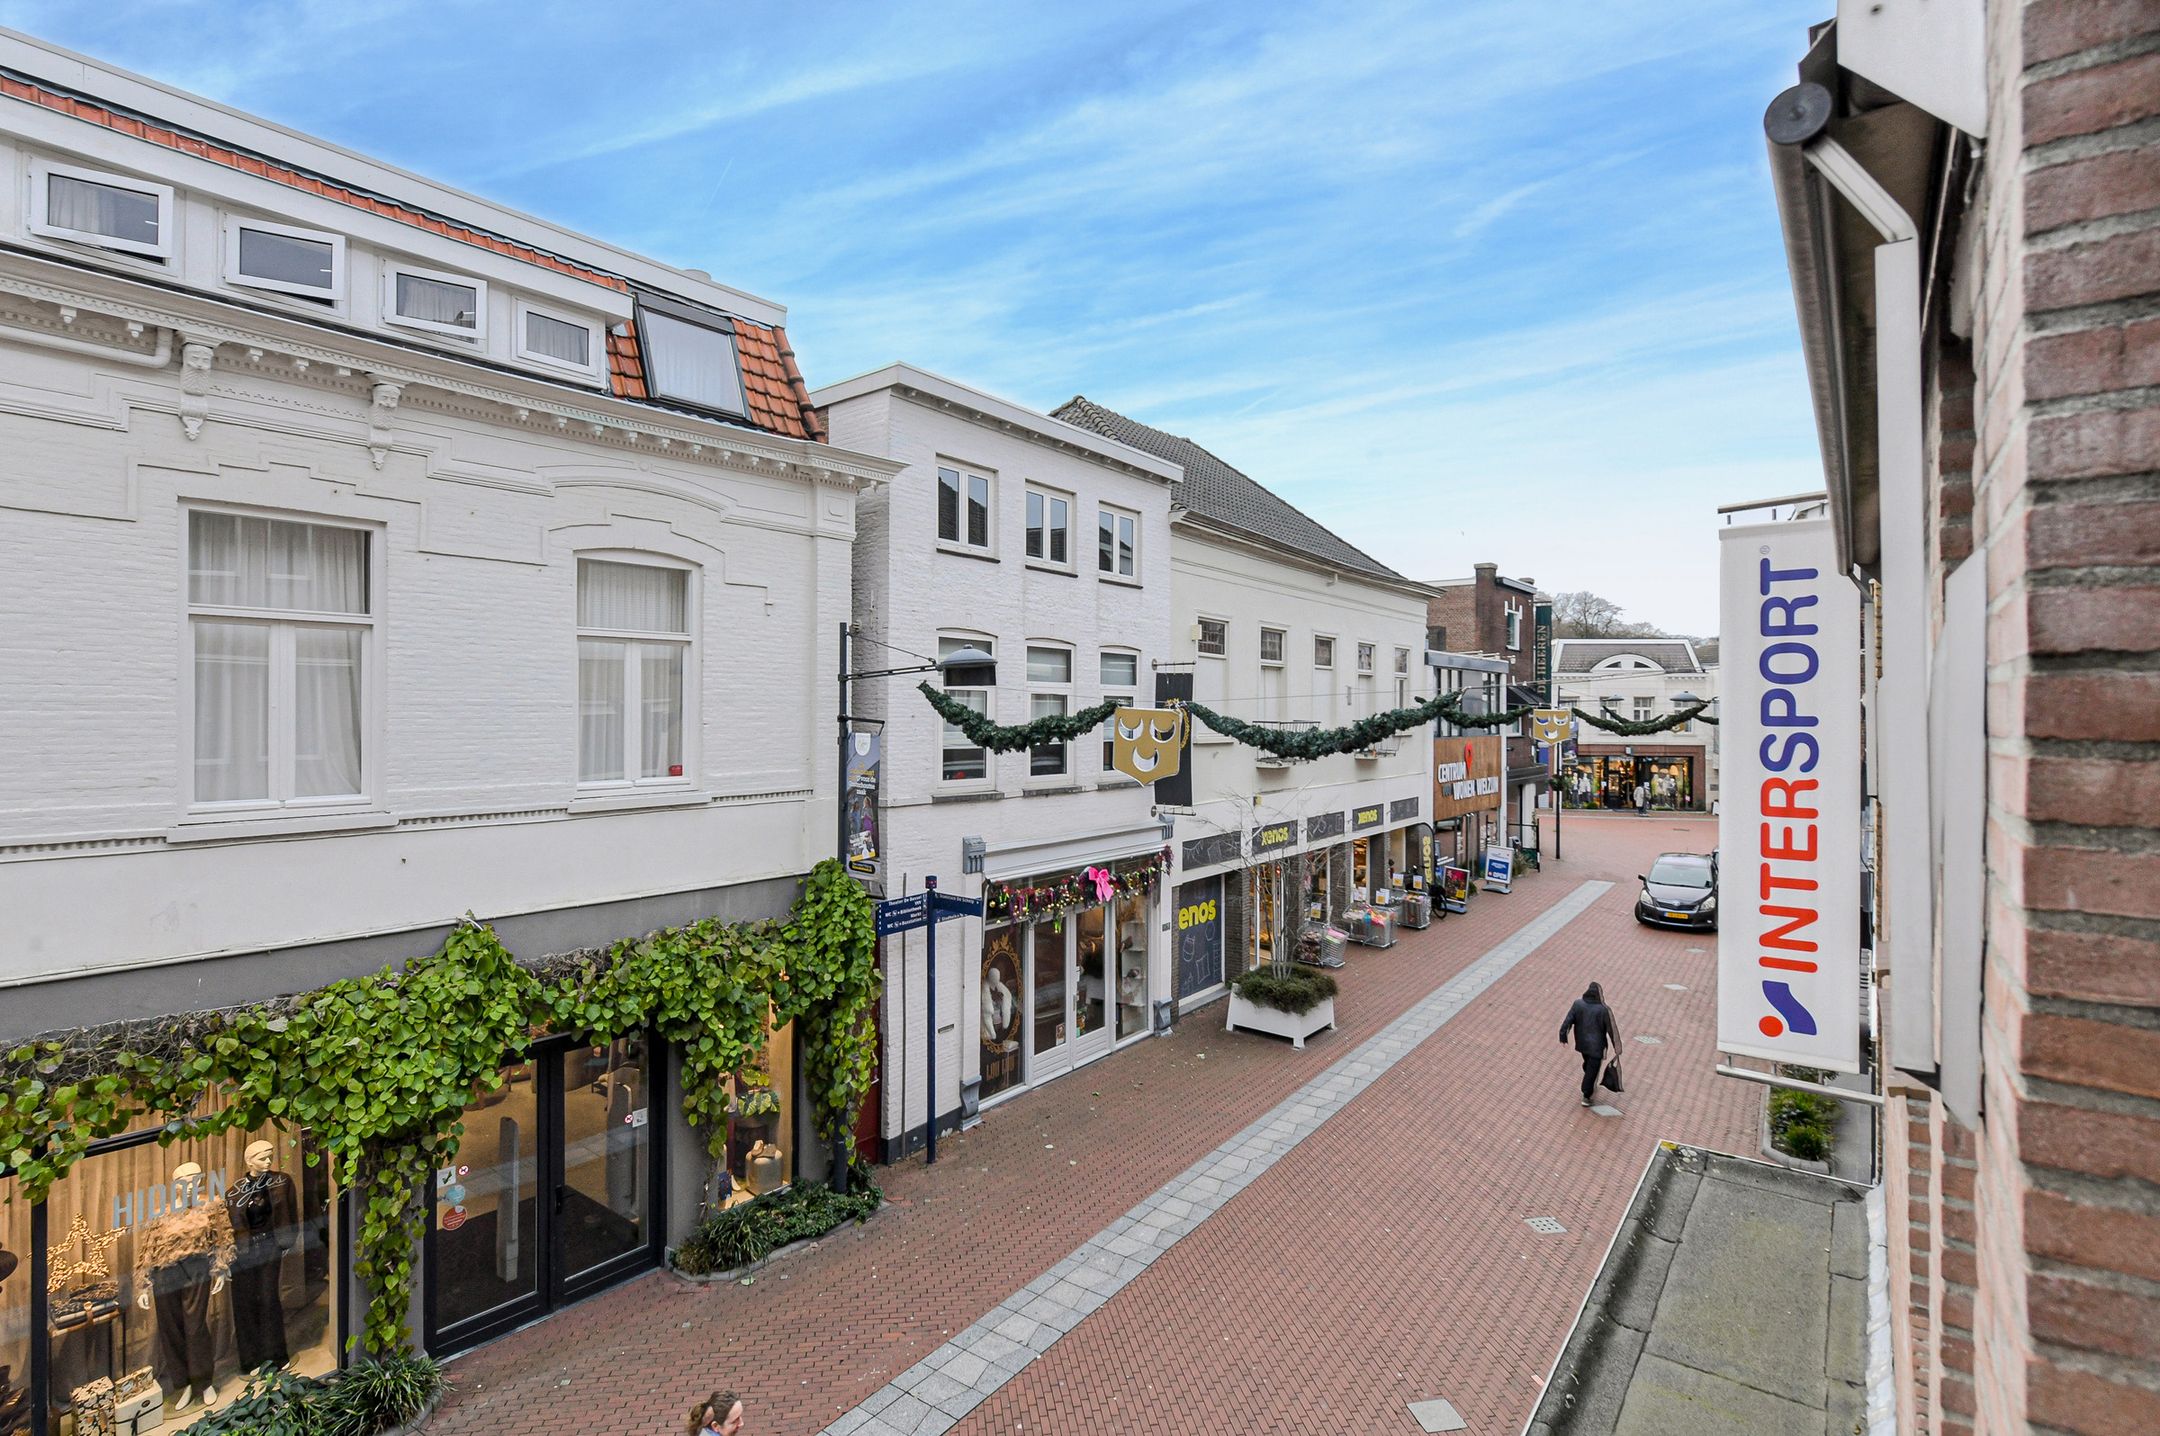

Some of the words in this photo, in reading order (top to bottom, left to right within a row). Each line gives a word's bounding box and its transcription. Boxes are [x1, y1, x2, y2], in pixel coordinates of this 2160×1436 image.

[1758, 557, 1819, 974] INTERSPORT
[112, 1167, 225, 1229] HIDDEN
[227, 1173, 287, 1209] Styles
